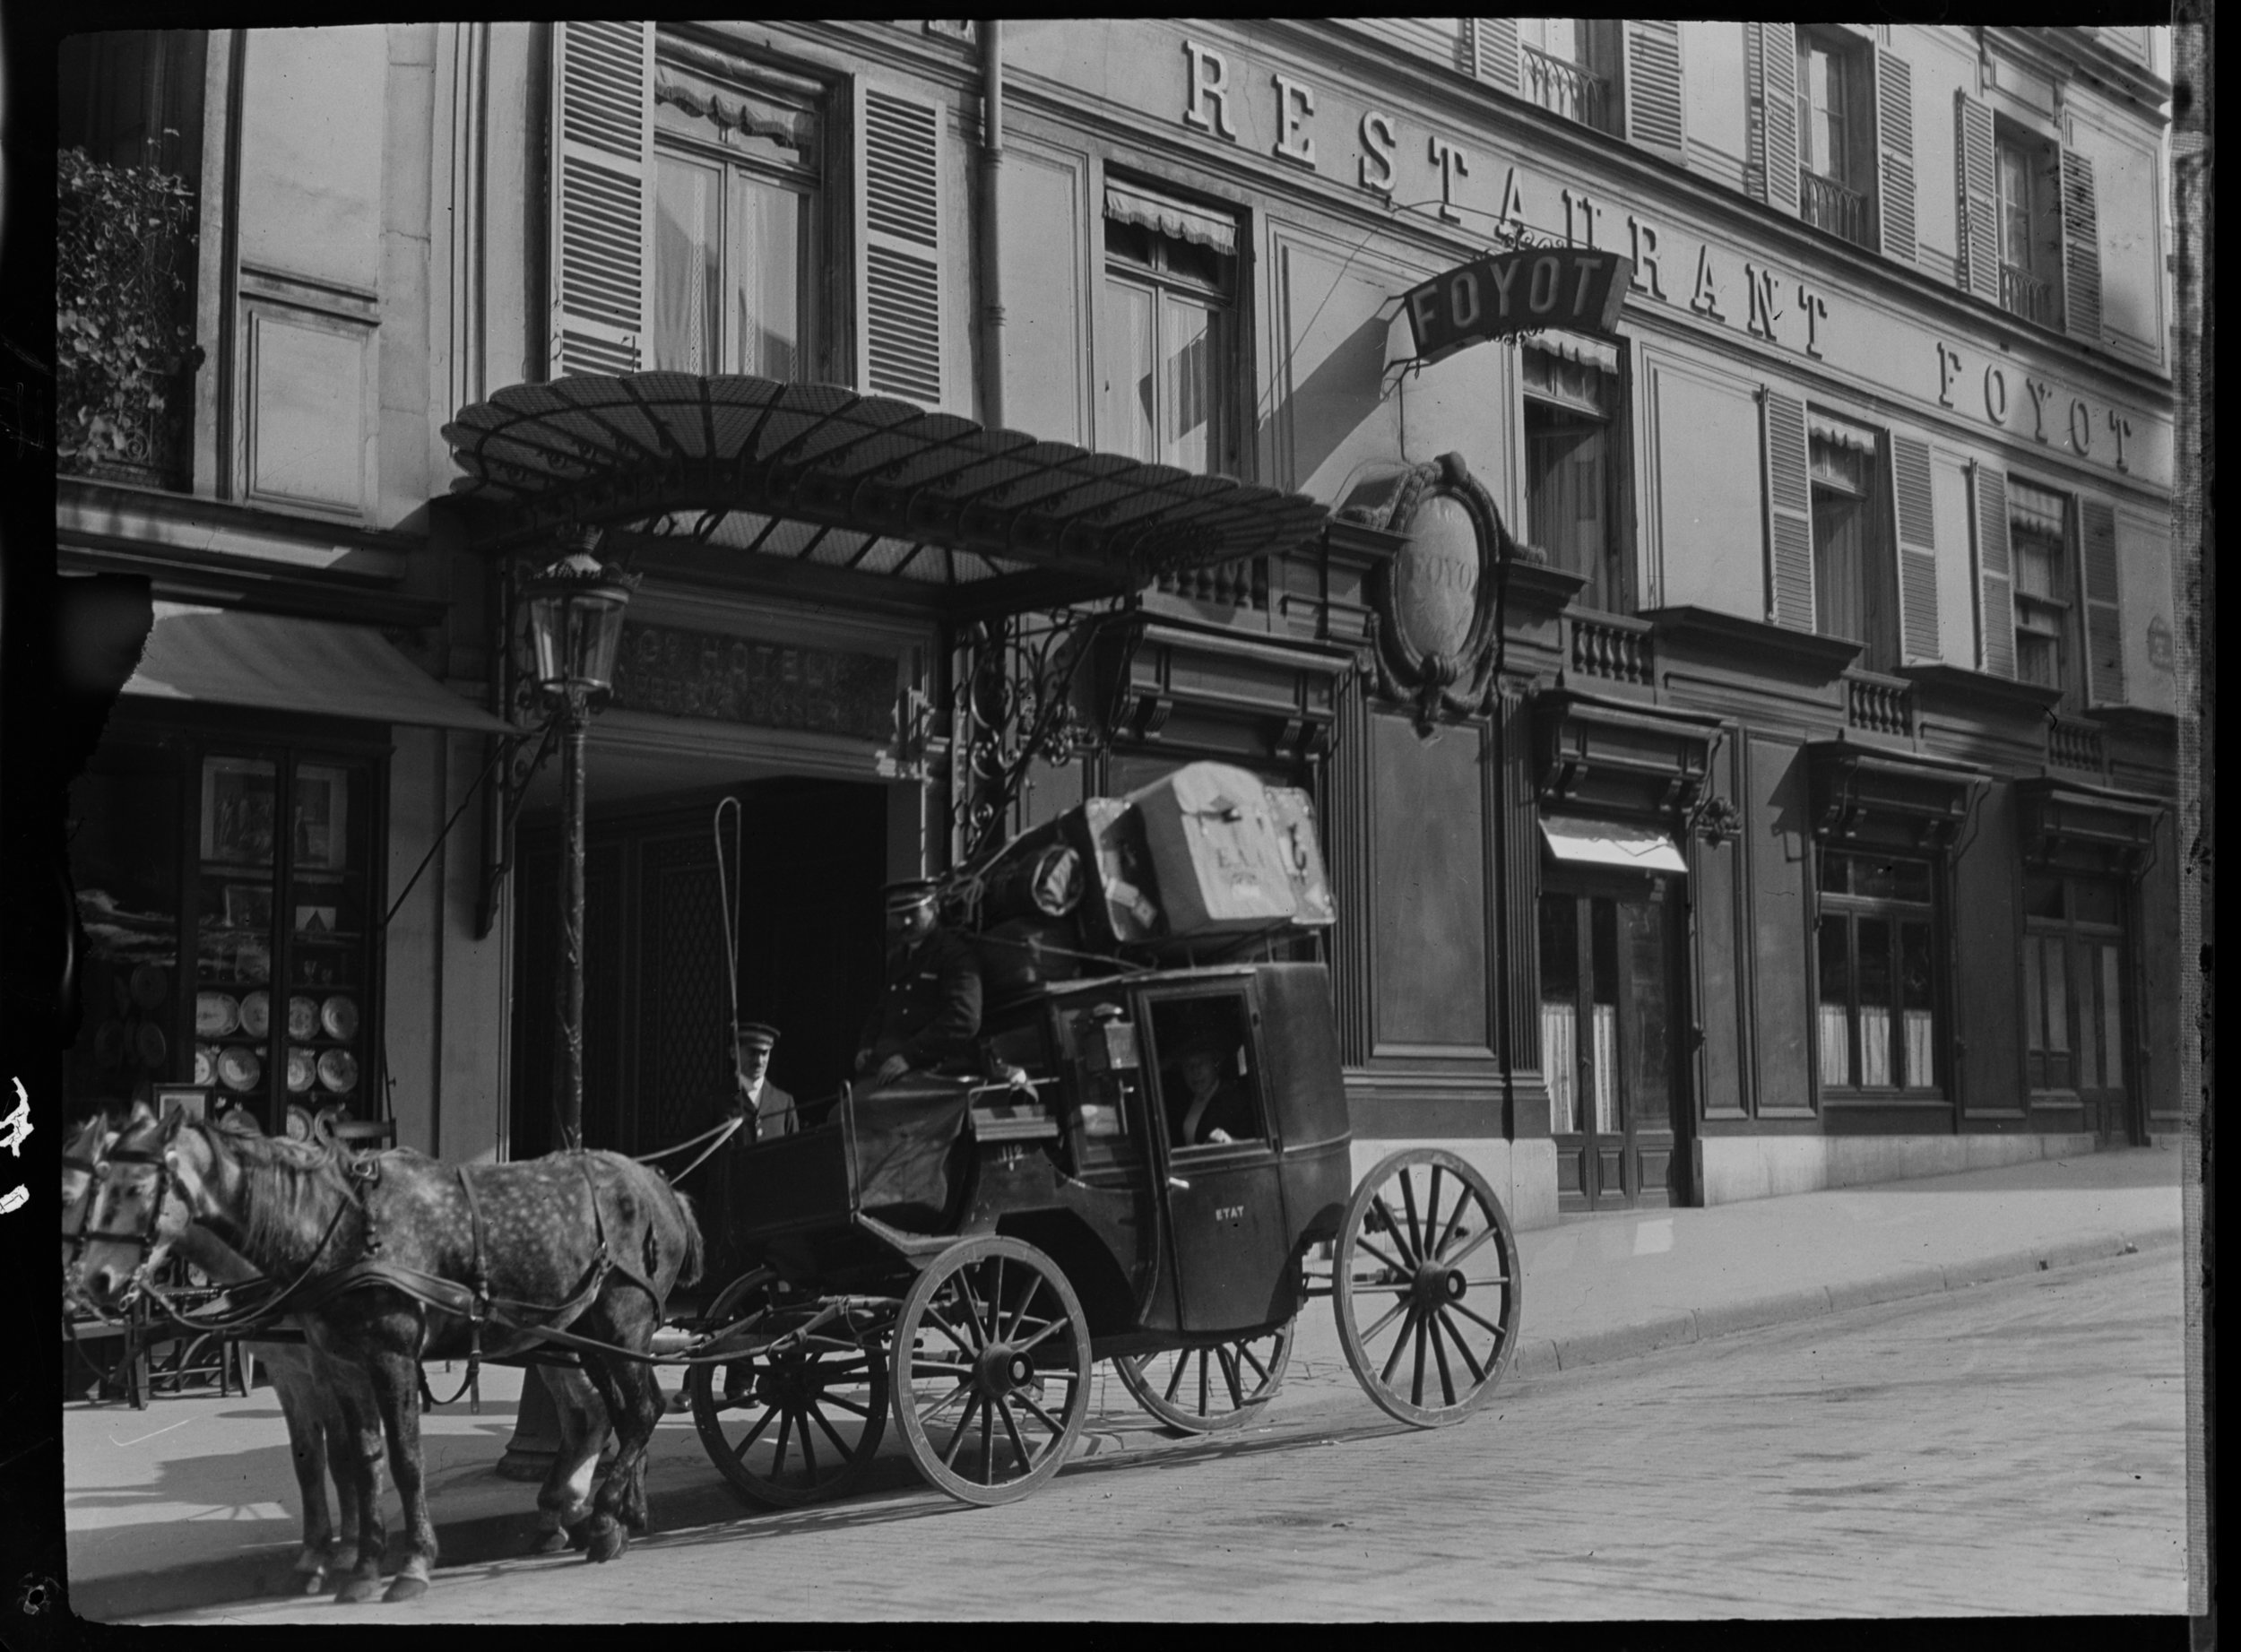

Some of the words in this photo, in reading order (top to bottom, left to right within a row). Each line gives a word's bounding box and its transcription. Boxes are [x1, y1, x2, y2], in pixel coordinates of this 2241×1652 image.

[1181, 39, 1828, 359] RESTAURANT
[1937, 342, 2132, 473] FOYOT
[1413, 256, 1602, 346] FOYOT
[1216, 1205, 1244, 1222] ETAT
